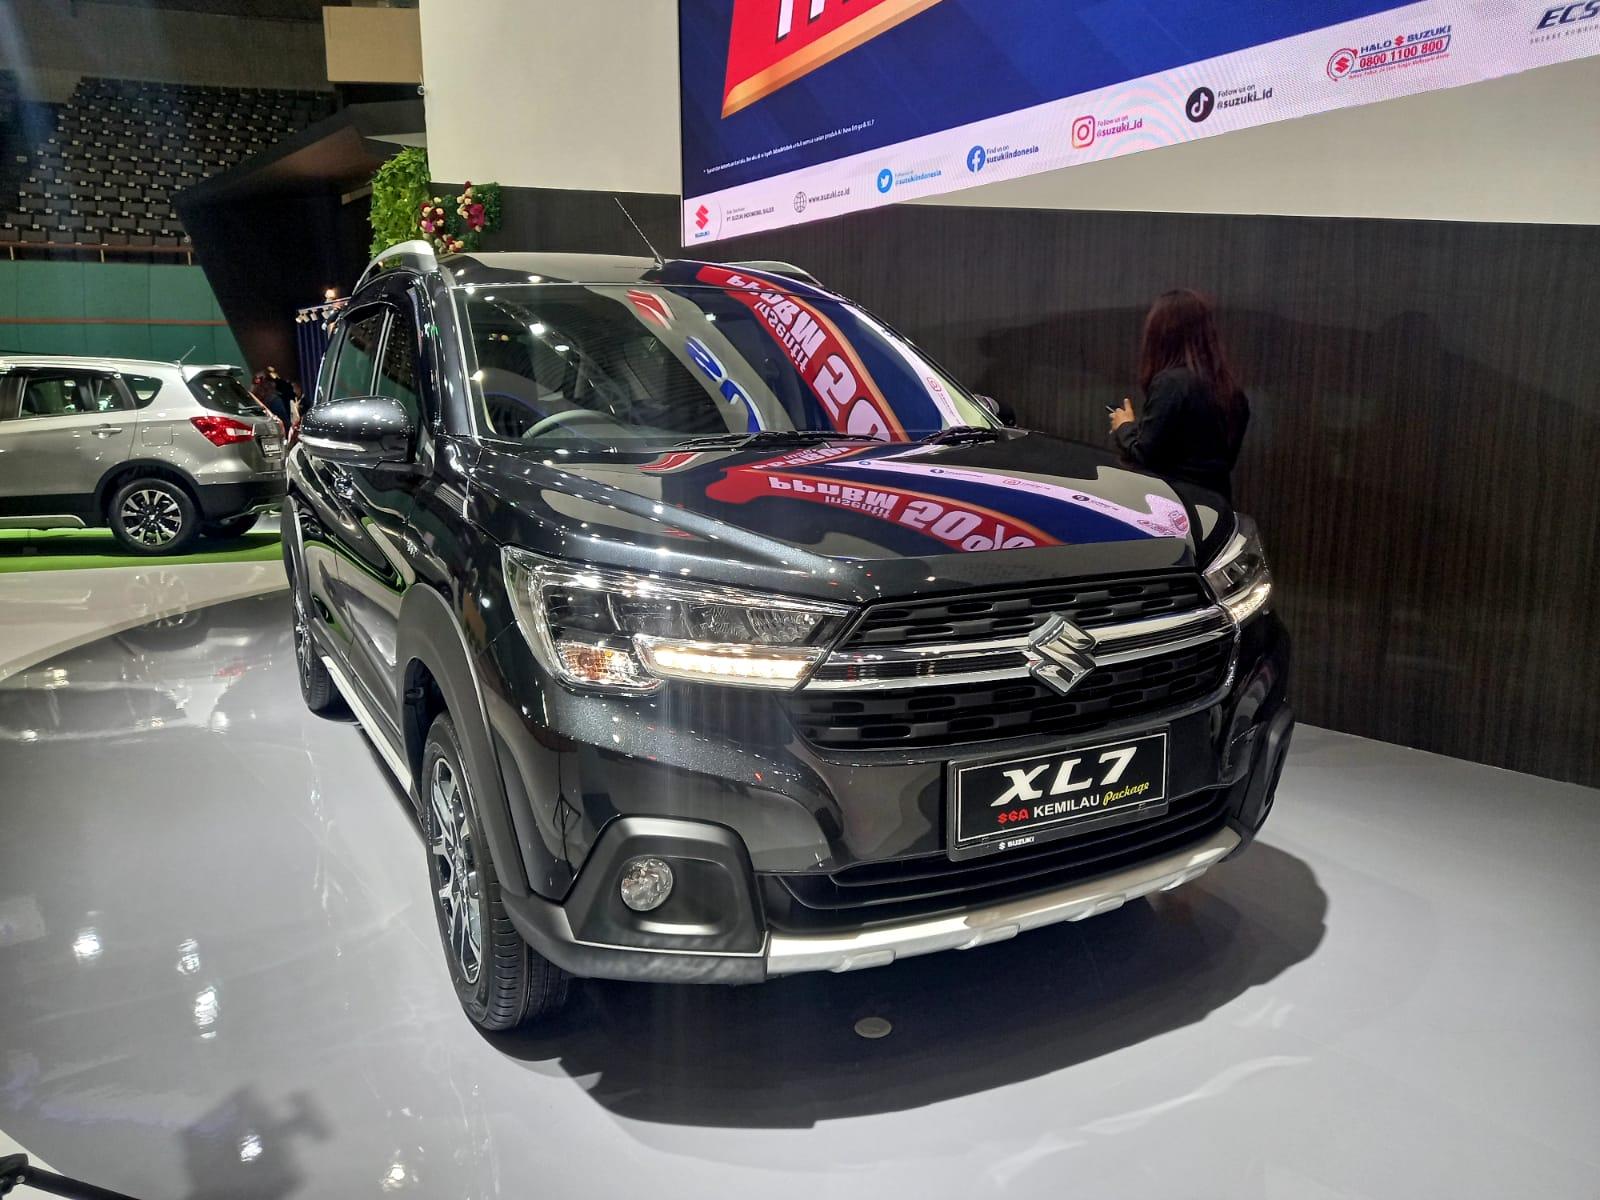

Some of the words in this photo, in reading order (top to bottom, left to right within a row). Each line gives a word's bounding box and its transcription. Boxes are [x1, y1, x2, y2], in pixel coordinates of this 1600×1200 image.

[1360, 39, 1392, 54] HALO
[1407, 25, 1451, 42] SUZUKI
[1360, 54, 1386, 69] 0800
[1390, 46, 1418, 62] 1100
[1421, 39, 1444, 53] 800
[1217, 87, 1273, 110] @suzuki_id
[986, 145, 1039, 164] suzukiindonesia
[808, 187, 850, 203] www.suzuki.co.id
[990, 747, 1138, 807] XL7
[1033, 794, 1100, 818] KEMILAU
[1102, 782, 1150, 806] Package
[1007, 836, 1035, 848] SUZUKI
